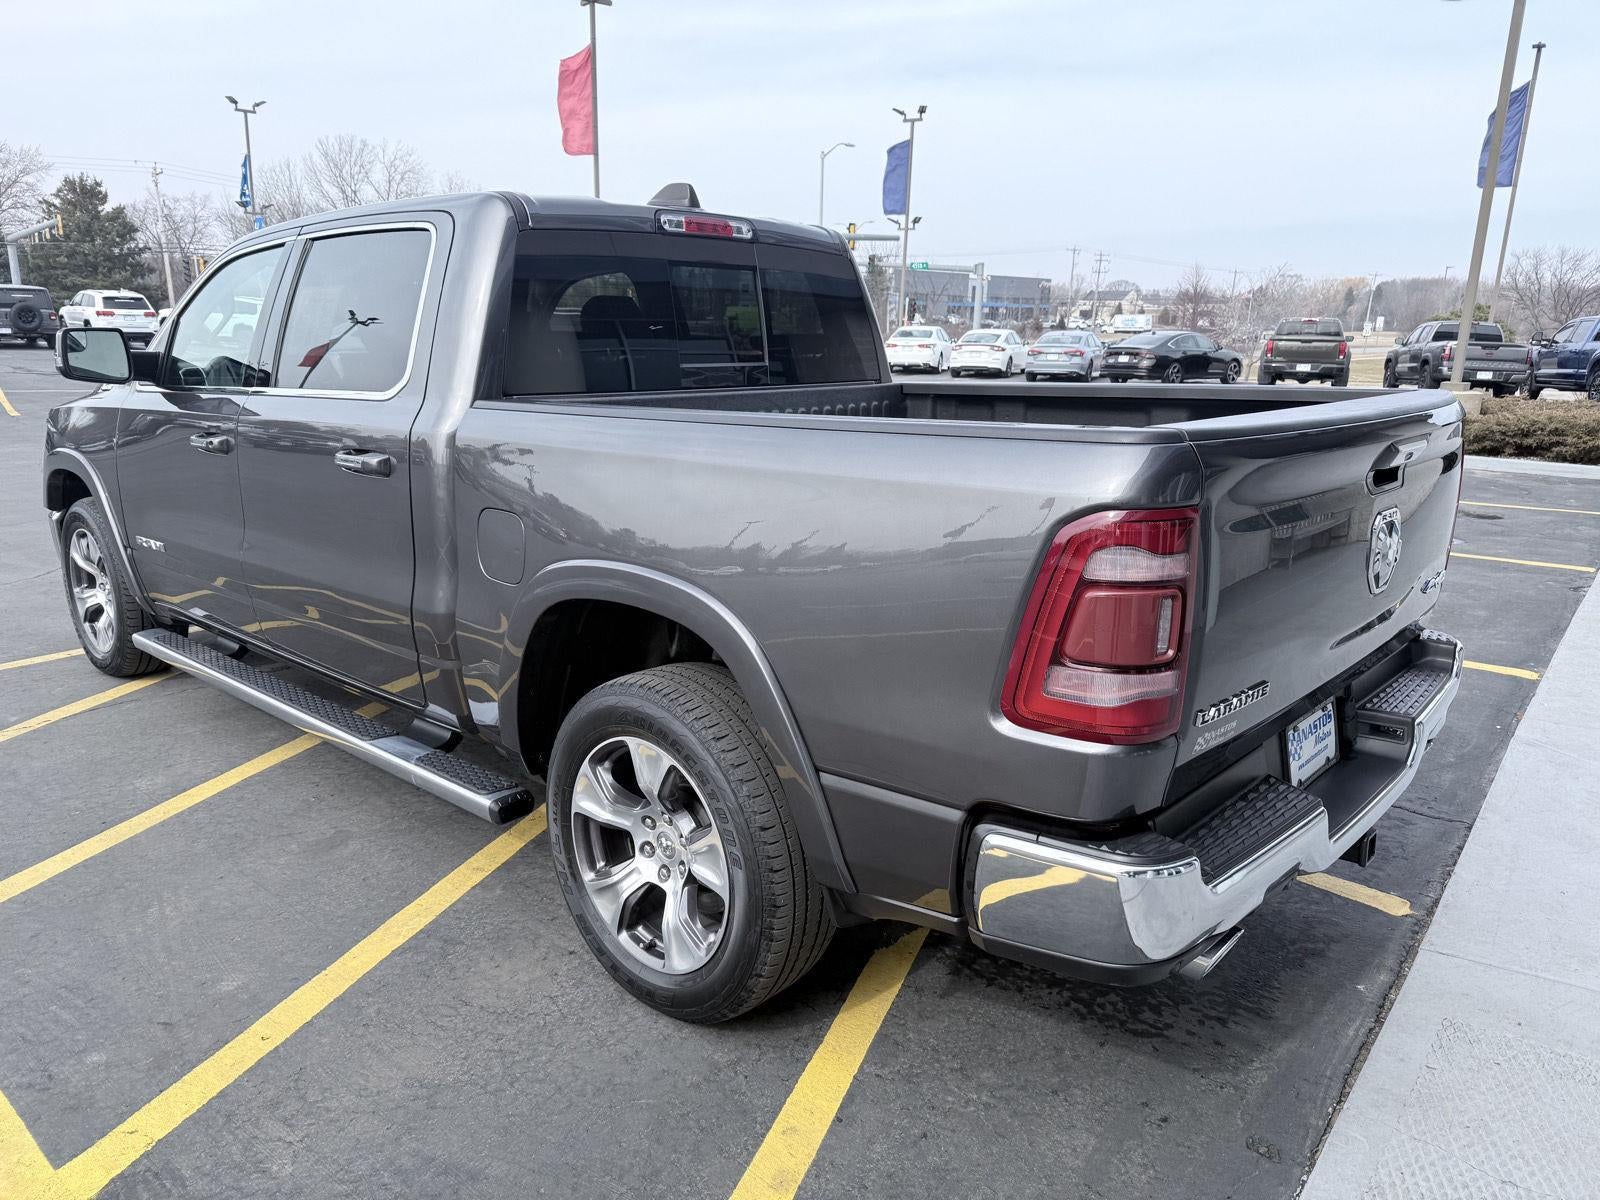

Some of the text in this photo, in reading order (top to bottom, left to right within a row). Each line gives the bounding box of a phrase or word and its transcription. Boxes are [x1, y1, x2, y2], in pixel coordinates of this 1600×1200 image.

[1381, 510, 1398, 522] RAM
[1194, 681, 1270, 728] LARAMIE
[1295, 709, 1333, 746] ANASTOS
